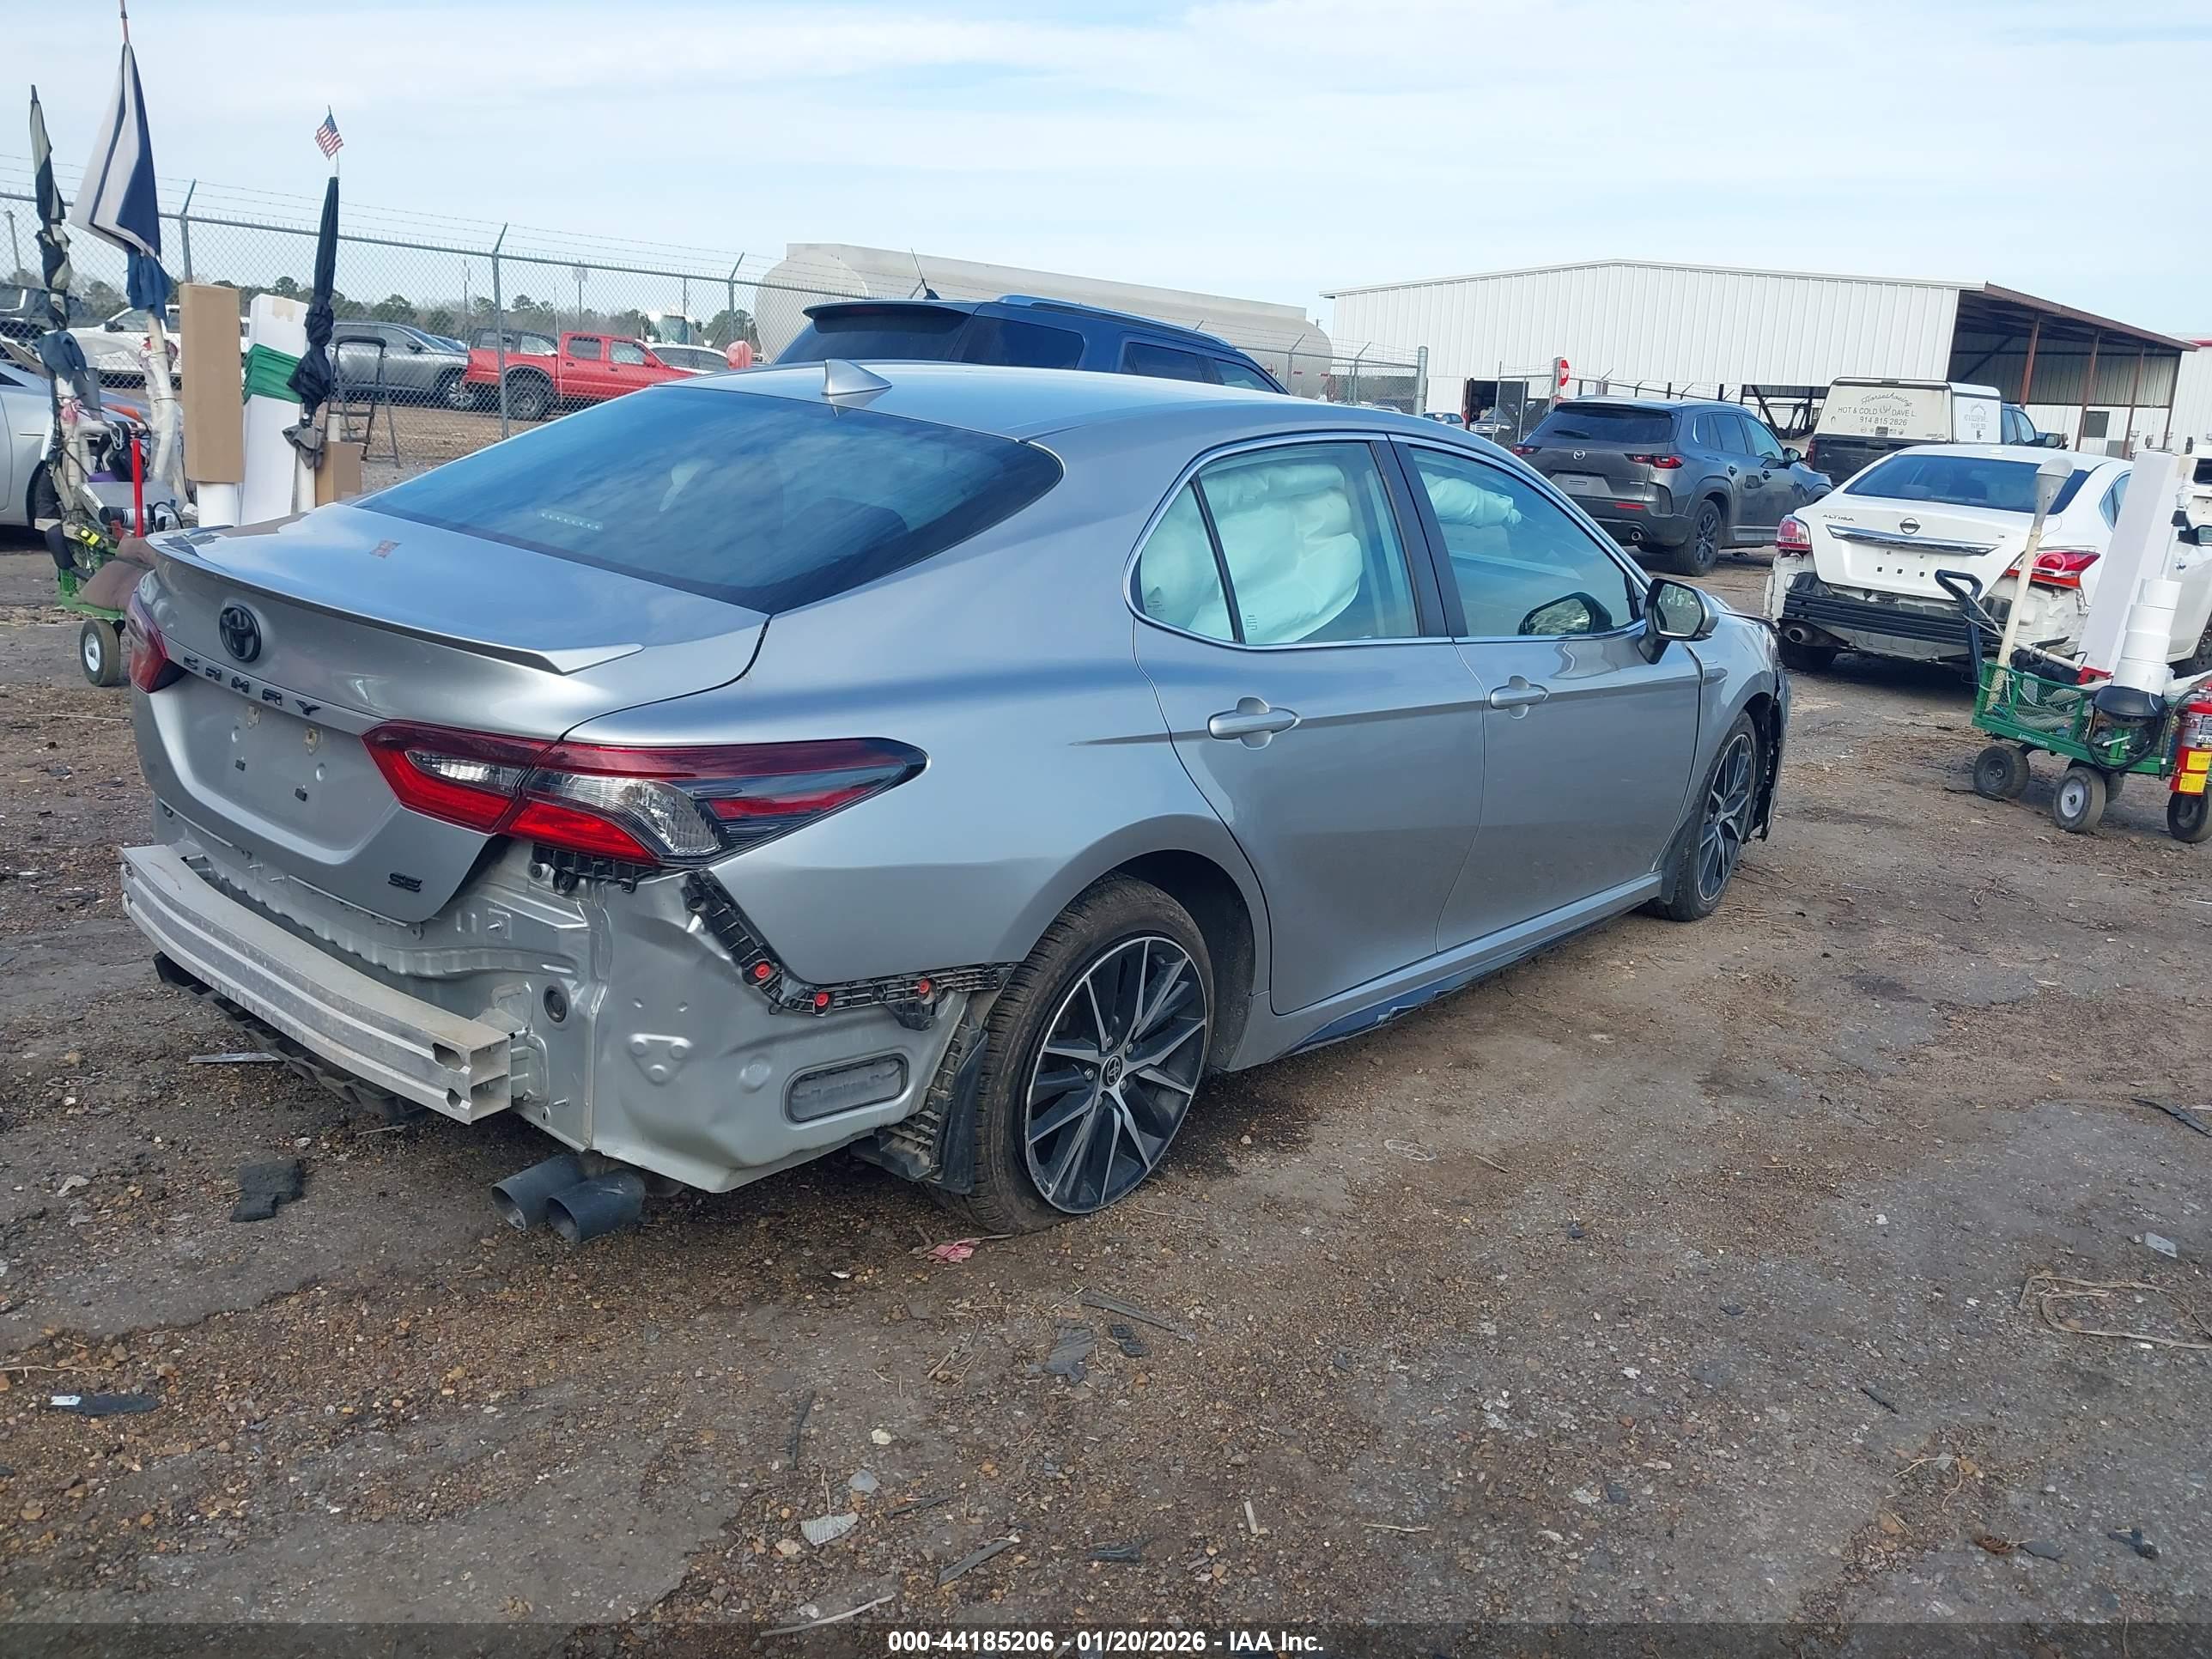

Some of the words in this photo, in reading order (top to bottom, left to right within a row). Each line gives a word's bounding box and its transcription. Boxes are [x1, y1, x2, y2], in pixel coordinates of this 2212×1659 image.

[1892, 409, 1910, 417] DAVE
[1874, 416, 1887, 425] 815
[1889, 417, 1907, 427] 2826
[183, 655, 321, 716] CAMRY
[387, 872, 422, 893] SE
